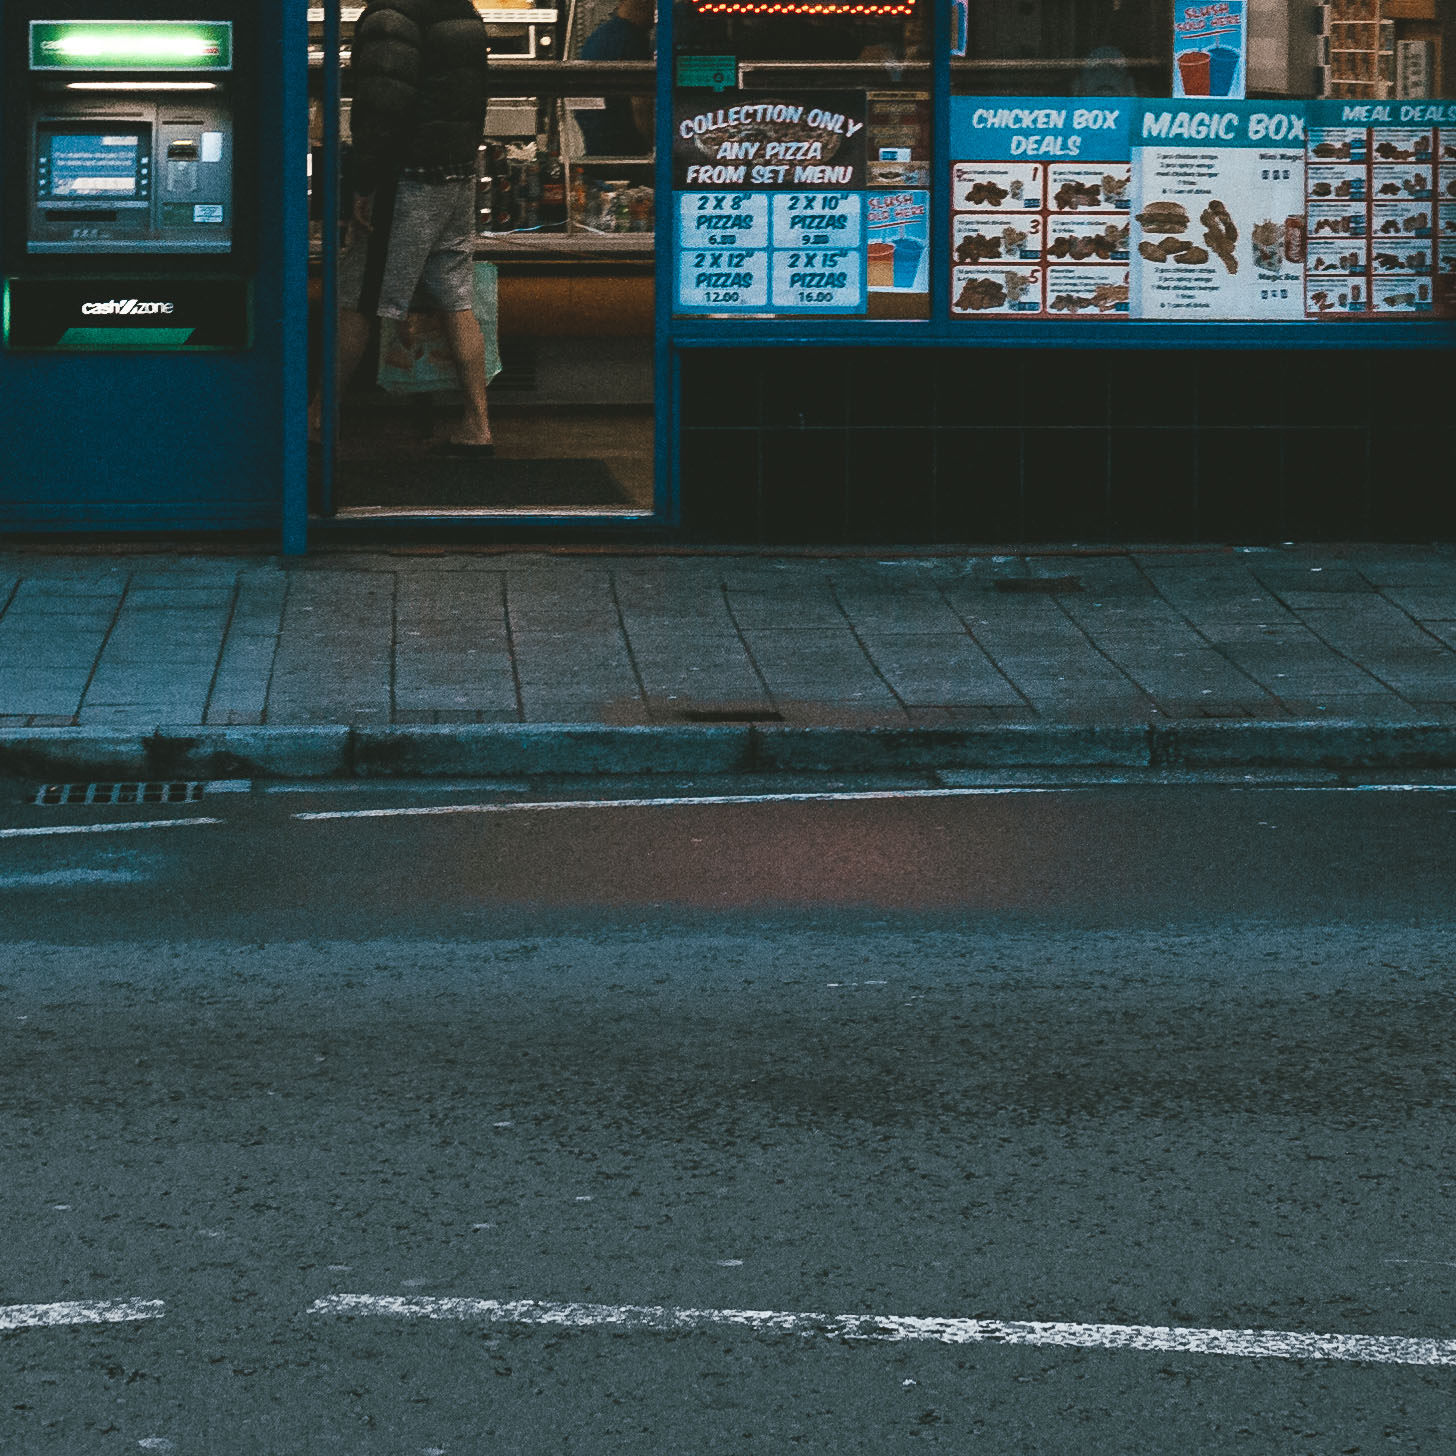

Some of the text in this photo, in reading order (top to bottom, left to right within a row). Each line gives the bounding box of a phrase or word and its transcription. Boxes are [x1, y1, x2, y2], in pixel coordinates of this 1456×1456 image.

[1184, 3, 1230, 20] SLUSH
[1210, 15, 1241, 27] HERE
[680, 104, 804, 139] COLLECTION
[807, 108, 863, 138] ONLY
[972, 108, 1120, 130] CHICKEN BOX
[1341, 105, 1393, 122] MEAL
[1142, 111, 1239, 140] MAGIC
[1247, 113, 1307, 142] BOX
[716, 142, 823, 161] ANY PIZZA
[1010, 135, 1082, 156] DEALS
[686, 165, 853, 184] FROM SET MENU
[697, 195, 707, 211] 2
[712, 196, 723, 211] X
[788, 195, 799, 211] 2
[805, 196, 817, 211] X
[696, 214, 754, 230] PIZZAS
[789, 214, 848, 230] PIZZAS
[866, 205, 926, 222] OLD HERE
[694, 253, 705, 268] 2
[708, 253, 722, 268] X
[788, 253, 798, 268] 2
[804, 253, 817, 268] X
[696, 272, 753, 289] PIZZAS
[789, 272, 848, 289] PIZZAS
[704, 291, 741, 303] 12.00
[798, 291, 833, 303] 16.00
